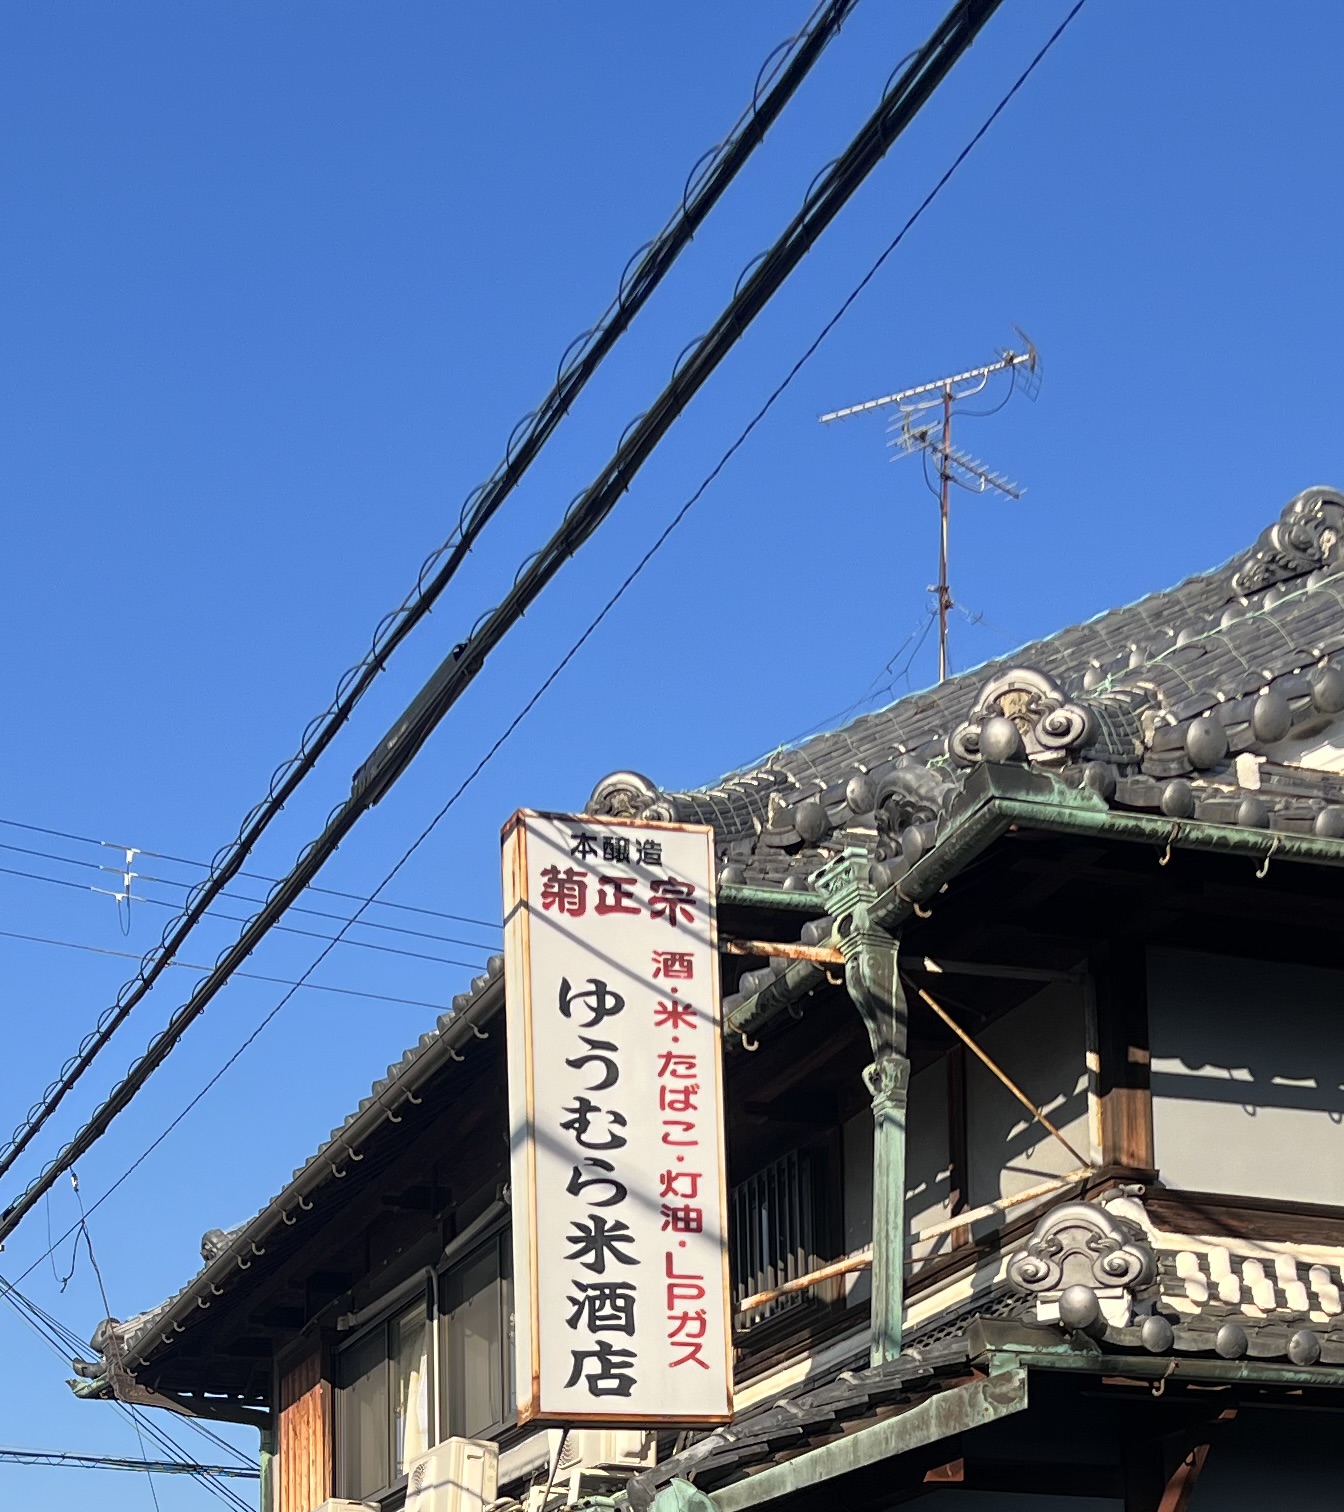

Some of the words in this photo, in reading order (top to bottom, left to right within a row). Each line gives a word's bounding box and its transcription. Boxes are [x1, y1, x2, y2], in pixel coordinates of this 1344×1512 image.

[540, 864, 697, 927] 菊正宗
[558, 976, 641, 1398] ゆうむら米酒店
